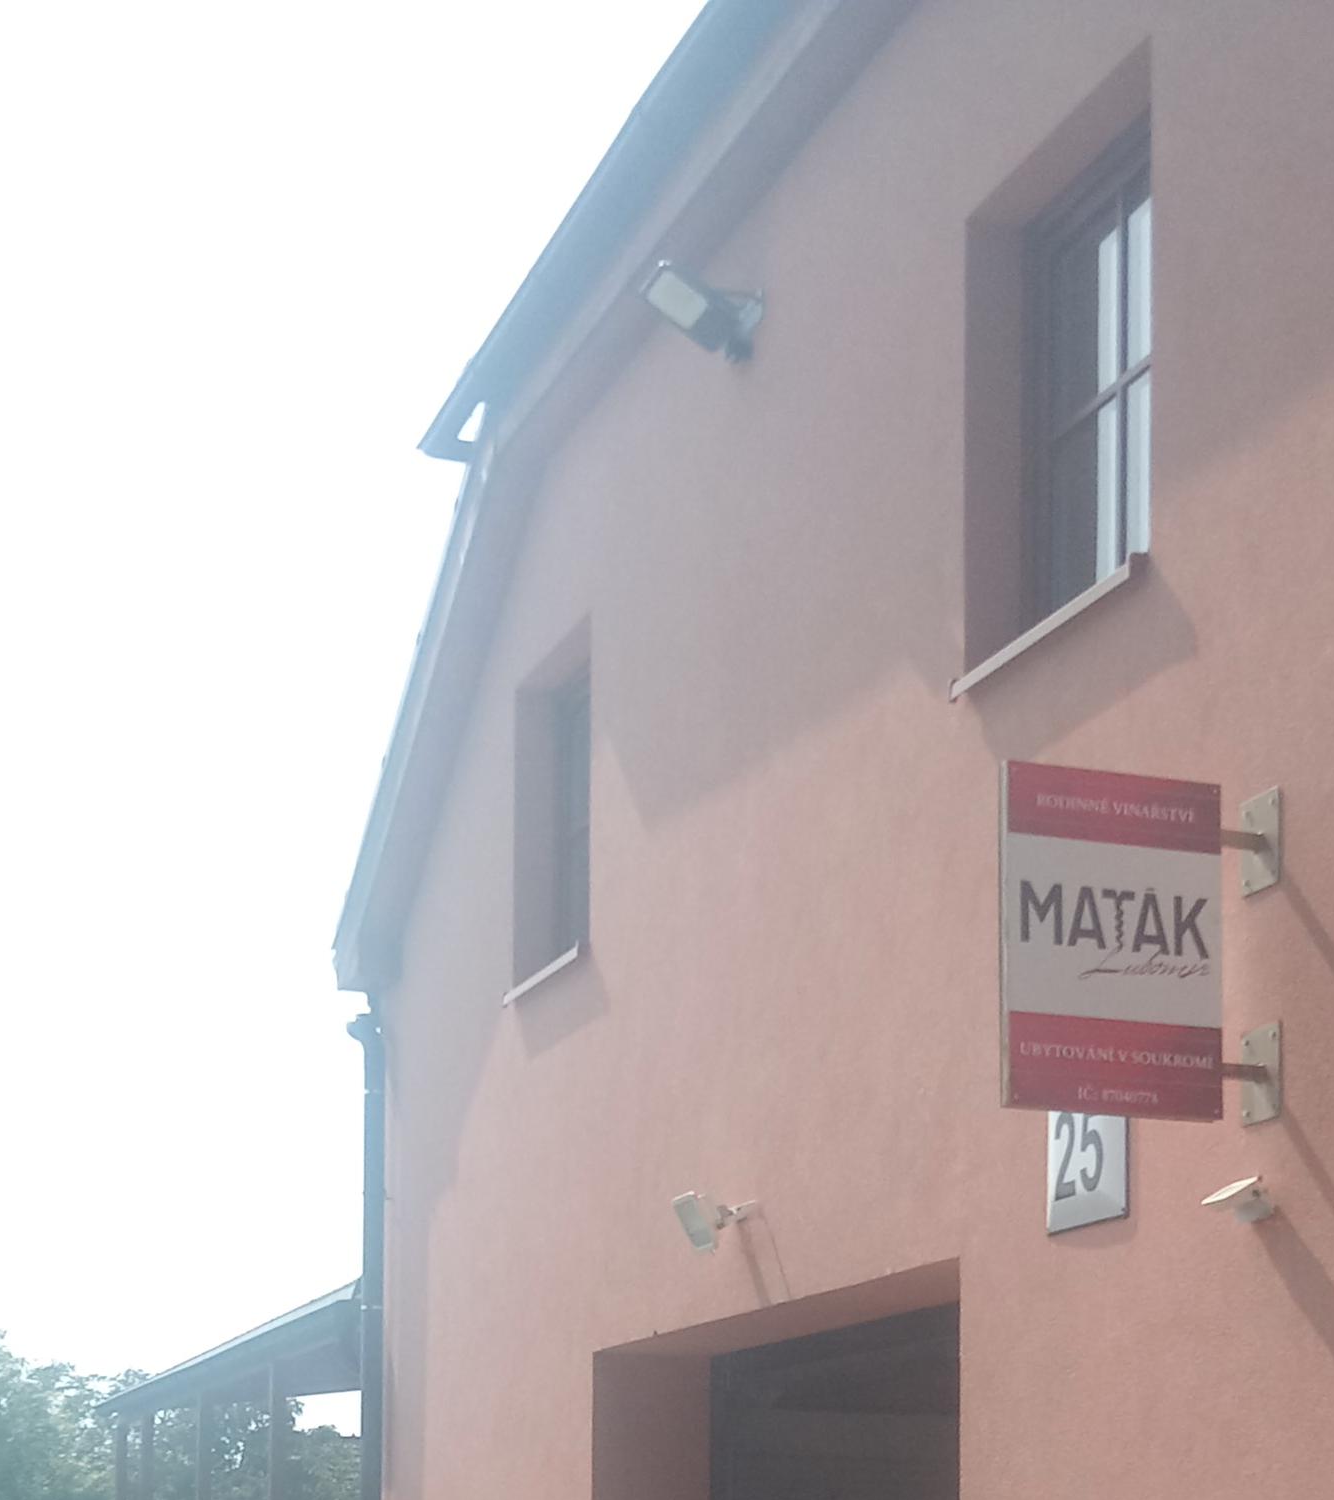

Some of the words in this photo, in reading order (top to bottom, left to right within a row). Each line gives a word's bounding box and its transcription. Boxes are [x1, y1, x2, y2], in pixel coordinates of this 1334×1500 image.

[1035, 793, 1109, 814] RODINNÉ
[1019, 1041, 1115, 1064] UBYTOVÁNÍ
[1116, 1049, 1127, 1064] V
[1130, 1050, 1215, 1070] SOUKROMÍ
[1054, 1112, 1104, 1202] 25
